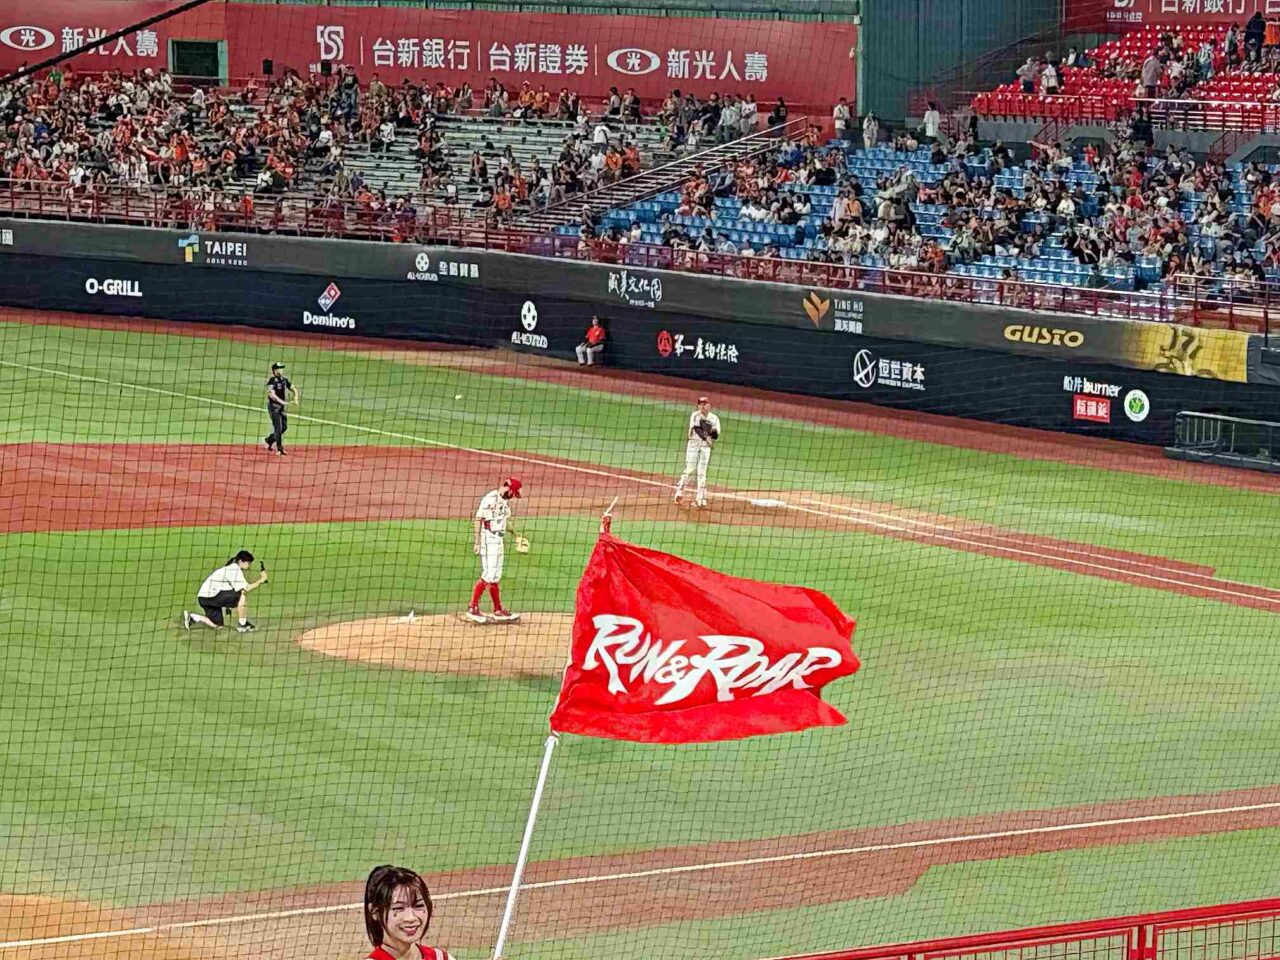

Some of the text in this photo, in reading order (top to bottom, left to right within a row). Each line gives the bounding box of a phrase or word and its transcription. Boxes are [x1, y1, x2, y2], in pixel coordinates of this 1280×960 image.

[62, 27, 158, 57] 新光人壽
[372, 36, 470, 71] 台新銀行
[488, 41, 589, 75] 台新證券
[666, 48, 768, 82] 新光人壽
[204, 240, 248, 257] TAIPEI
[85, 278, 143, 297] O-GRILL
[303, 311, 356, 329] Domino's
[1004, 324, 1084, 347] GUSTO
